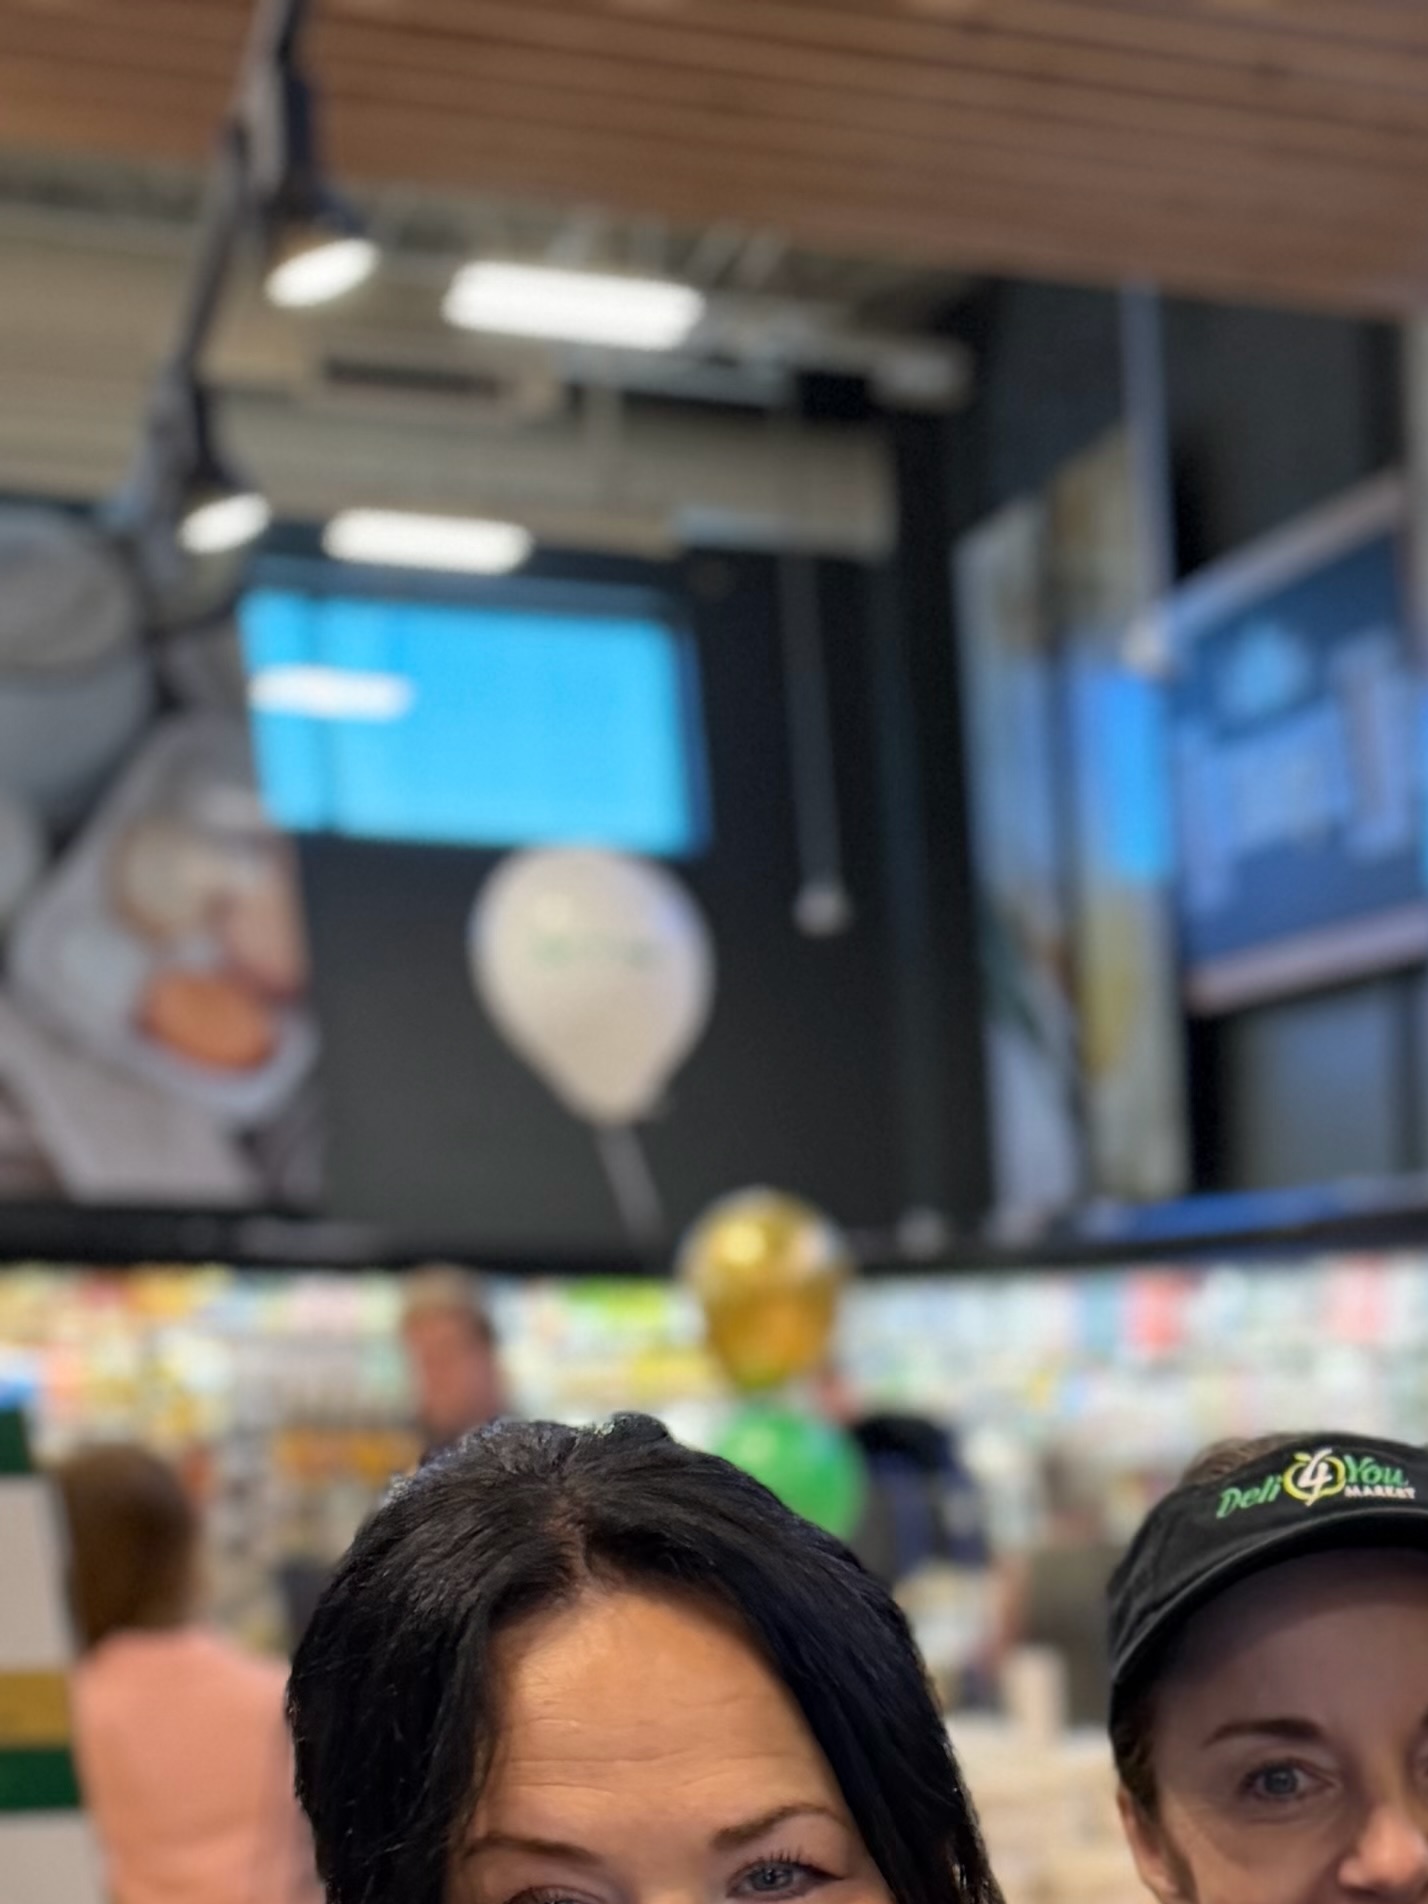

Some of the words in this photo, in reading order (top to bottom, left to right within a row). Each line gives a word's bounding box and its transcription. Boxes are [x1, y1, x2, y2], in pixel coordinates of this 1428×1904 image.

[1216, 1475, 1282, 1519] Deli
[1298, 1448, 1332, 1507] 4
[1344, 1454, 1408, 1486] You
[1344, 1485, 1416, 1499] MARKET
